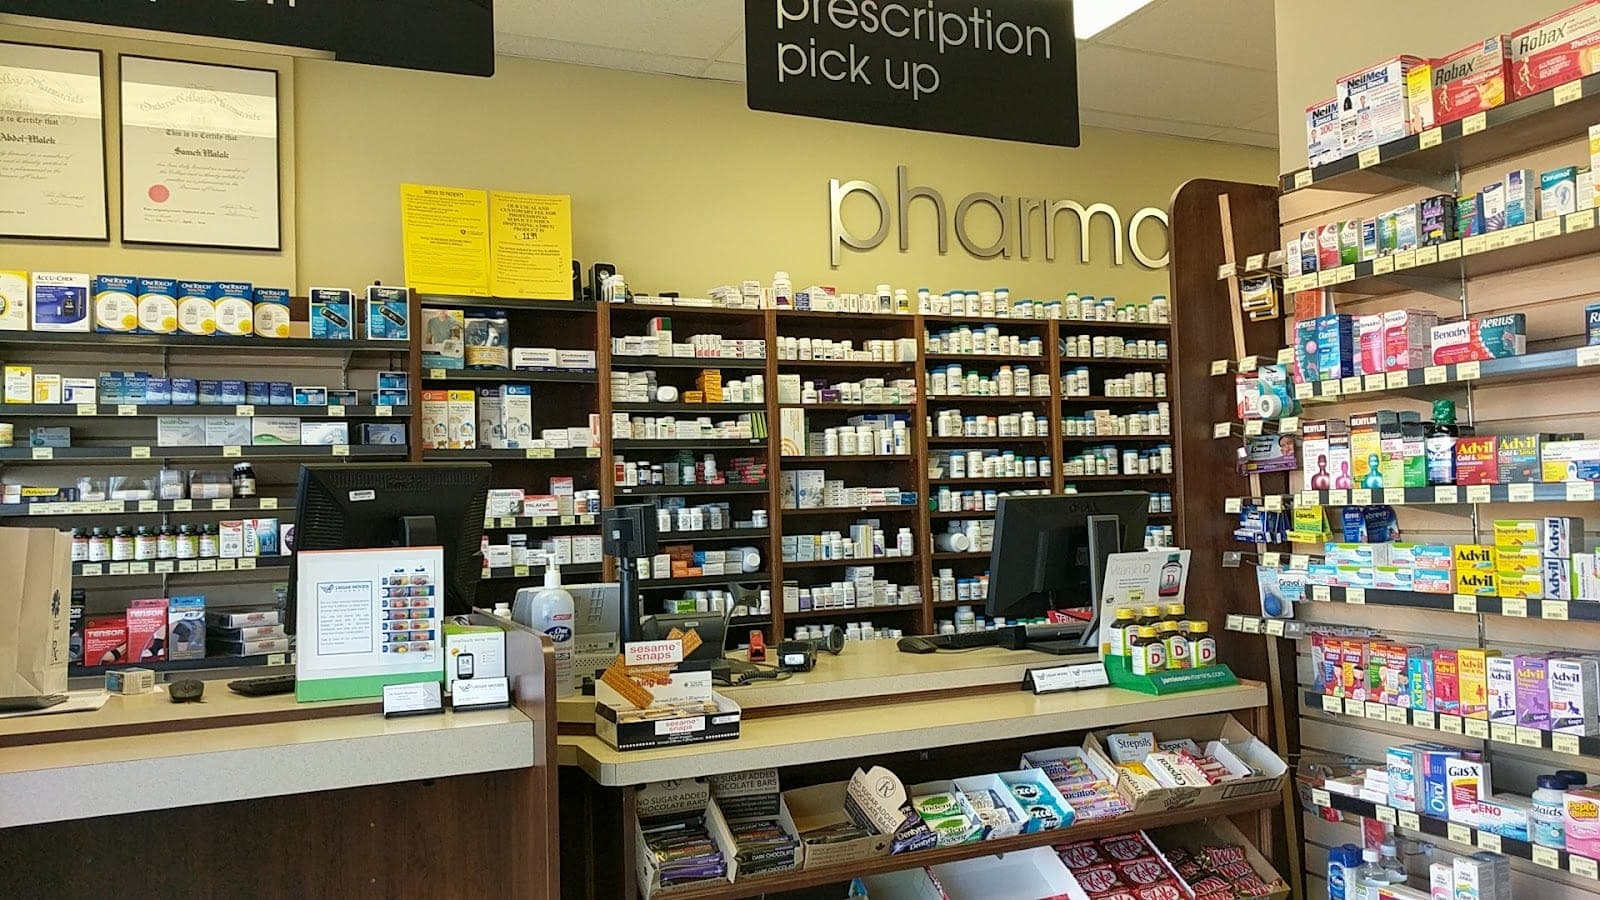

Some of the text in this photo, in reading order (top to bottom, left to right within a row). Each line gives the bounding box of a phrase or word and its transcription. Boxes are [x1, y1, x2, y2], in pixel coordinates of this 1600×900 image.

[777, 0, 1051, 59] prescription
[1520, 22, 1567, 55] Robax
[776, 38, 941, 100] pick up
[1435, 57, 1476, 86] Robax
[1347, 67, 1388, 89] NeilMed
[1312, 102, 1338, 120] NeilM
[165, 128, 182, 137] This
[200, 131, 224, 141] Certify
[1433, 325, 1470, 341] Benadryl
[389, 432, 398, 444] 6
[1500, 436, 1536, 450] Advil
[1458, 441, 1493, 455] Advil
[1548, 519, 1560, 556] Advil
[1457, 549, 1490, 562] Advil
[1142, 563, 1152, 574] D
[1459, 574, 1493, 587] Advil
[1548, 560, 1561, 598] Advil
[630, 643, 676, 653] sesame
[1175, 645, 1184, 656] D
[1203, 648, 1211, 659] D
[635, 651, 672, 661] snaps
[1152, 653, 1160, 664] D
[1434, 663, 1456, 674] Advil
[1461, 660, 1483, 669] Advil
[1490, 672, 1512, 682] Advil
[1517, 668, 1545, 680] Advil
[1552, 671, 1580, 683] Advil
[665, 719, 696, 727] sesame
[1117, 738, 1152, 750] Strepsils
[1157, 758, 1186, 785] Cepacol
[1388, 764, 1411, 775] Gravol
[720, 773, 747, 783] SUGAR
[748, 770, 776, 780] ADDED
[757, 779, 778, 787] BARS
[638, 790, 708, 806] NO SUGAR ADDED
[1062, 788, 1097, 800] mentos
[1431, 781, 1446, 813] Ovol
[636, 798, 707, 813] CHOCOLATE BARS
[860, 787, 879, 807] SUGAR
[879, 806, 898, 828] ADDED
[1479, 804, 1502, 817] ENO
[877, 815, 895, 833] BARS
[897, 825, 928, 841] Dentyne
[909, 836, 938, 851] Dentyne
